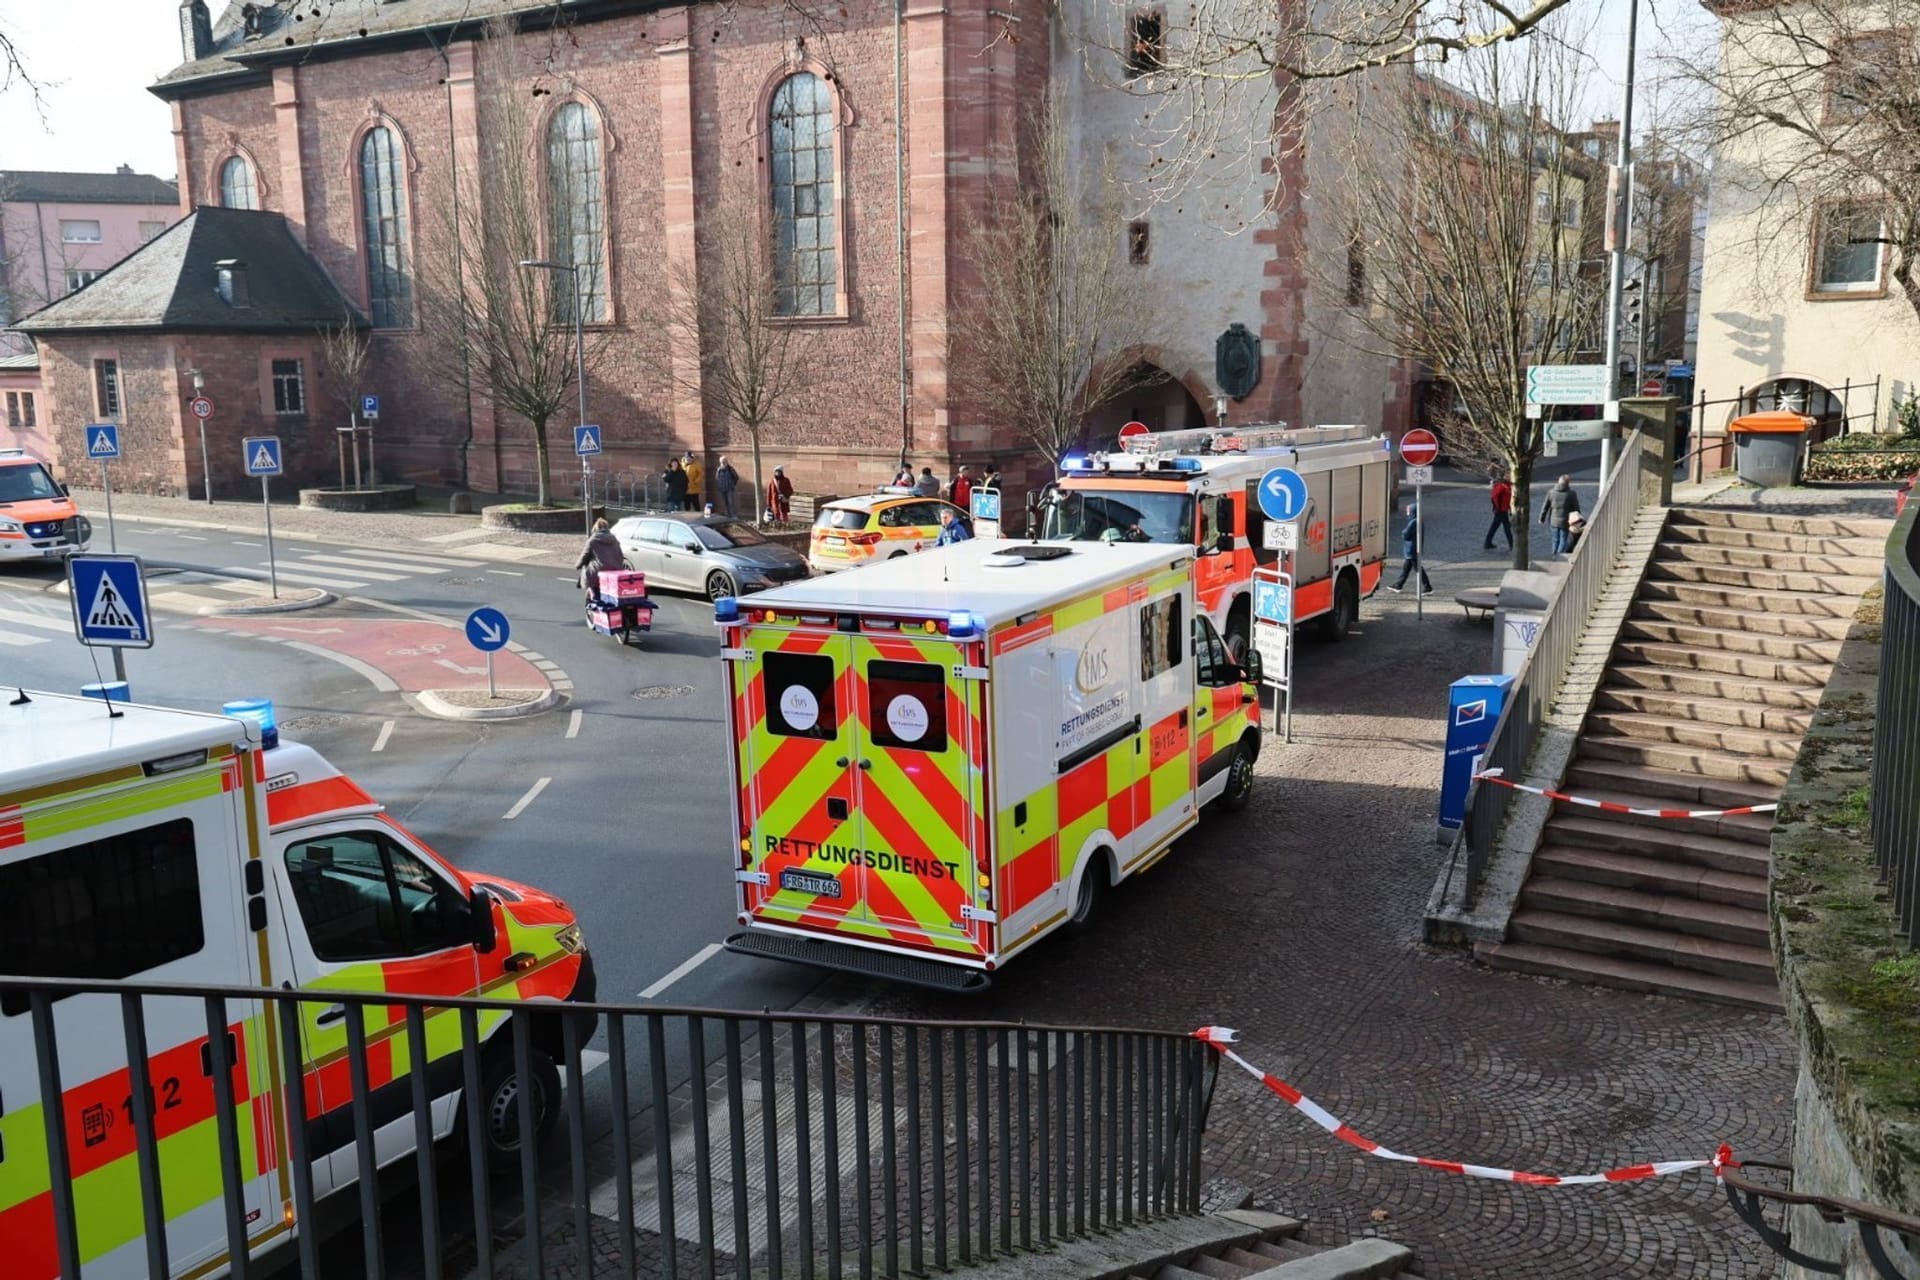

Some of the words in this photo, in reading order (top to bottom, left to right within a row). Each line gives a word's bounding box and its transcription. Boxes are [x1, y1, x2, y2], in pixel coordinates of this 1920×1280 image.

[196, 403, 208, 414] 30
[365, 397, 374, 409] P
[1061, 693, 1124, 736] RETTUNGSDIENST
[1162, 729, 1176, 750] 112
[765, 835, 959, 881] RETTUNGSDIENST
[785, 875, 803, 888] FRG
[809, 879, 820, 891] TR
[822, 881, 839, 894] 662
